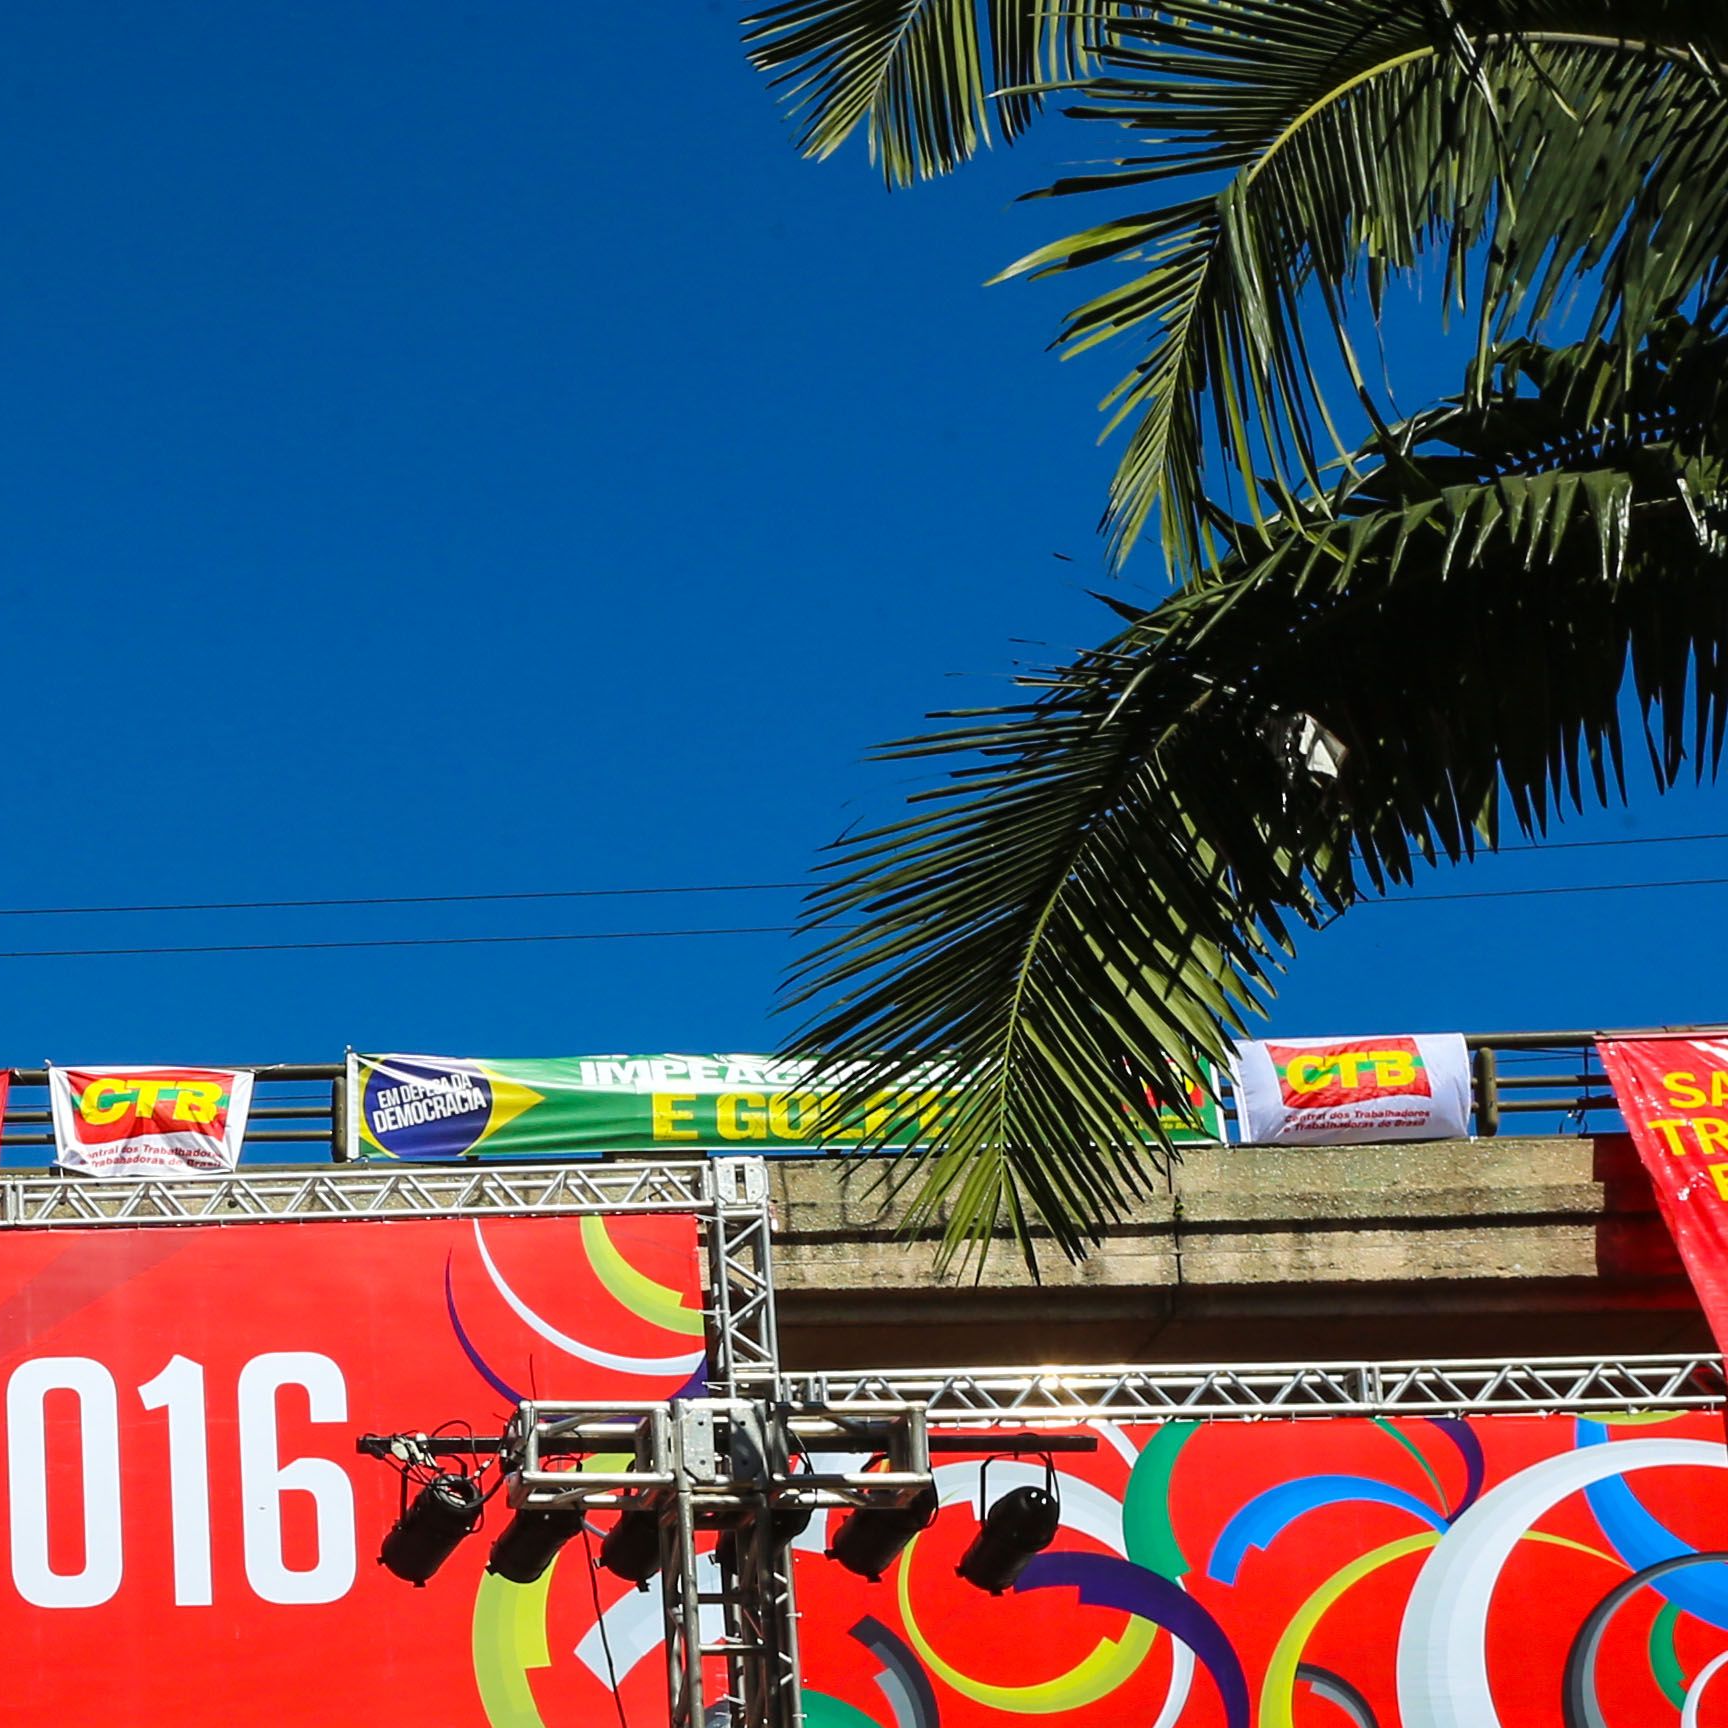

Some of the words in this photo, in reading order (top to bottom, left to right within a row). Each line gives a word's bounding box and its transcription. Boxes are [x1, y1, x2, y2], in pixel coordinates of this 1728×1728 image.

[377, 1085, 400, 1109] EM
[400, 1078, 450, 1104] DEFESA
[450, 1072, 473, 1091] DA
[1286, 1051, 1417, 1095] CTB
[81, 1078, 224, 1126] CTB
[372, 1087, 487, 1134] DEMOCRACIA
